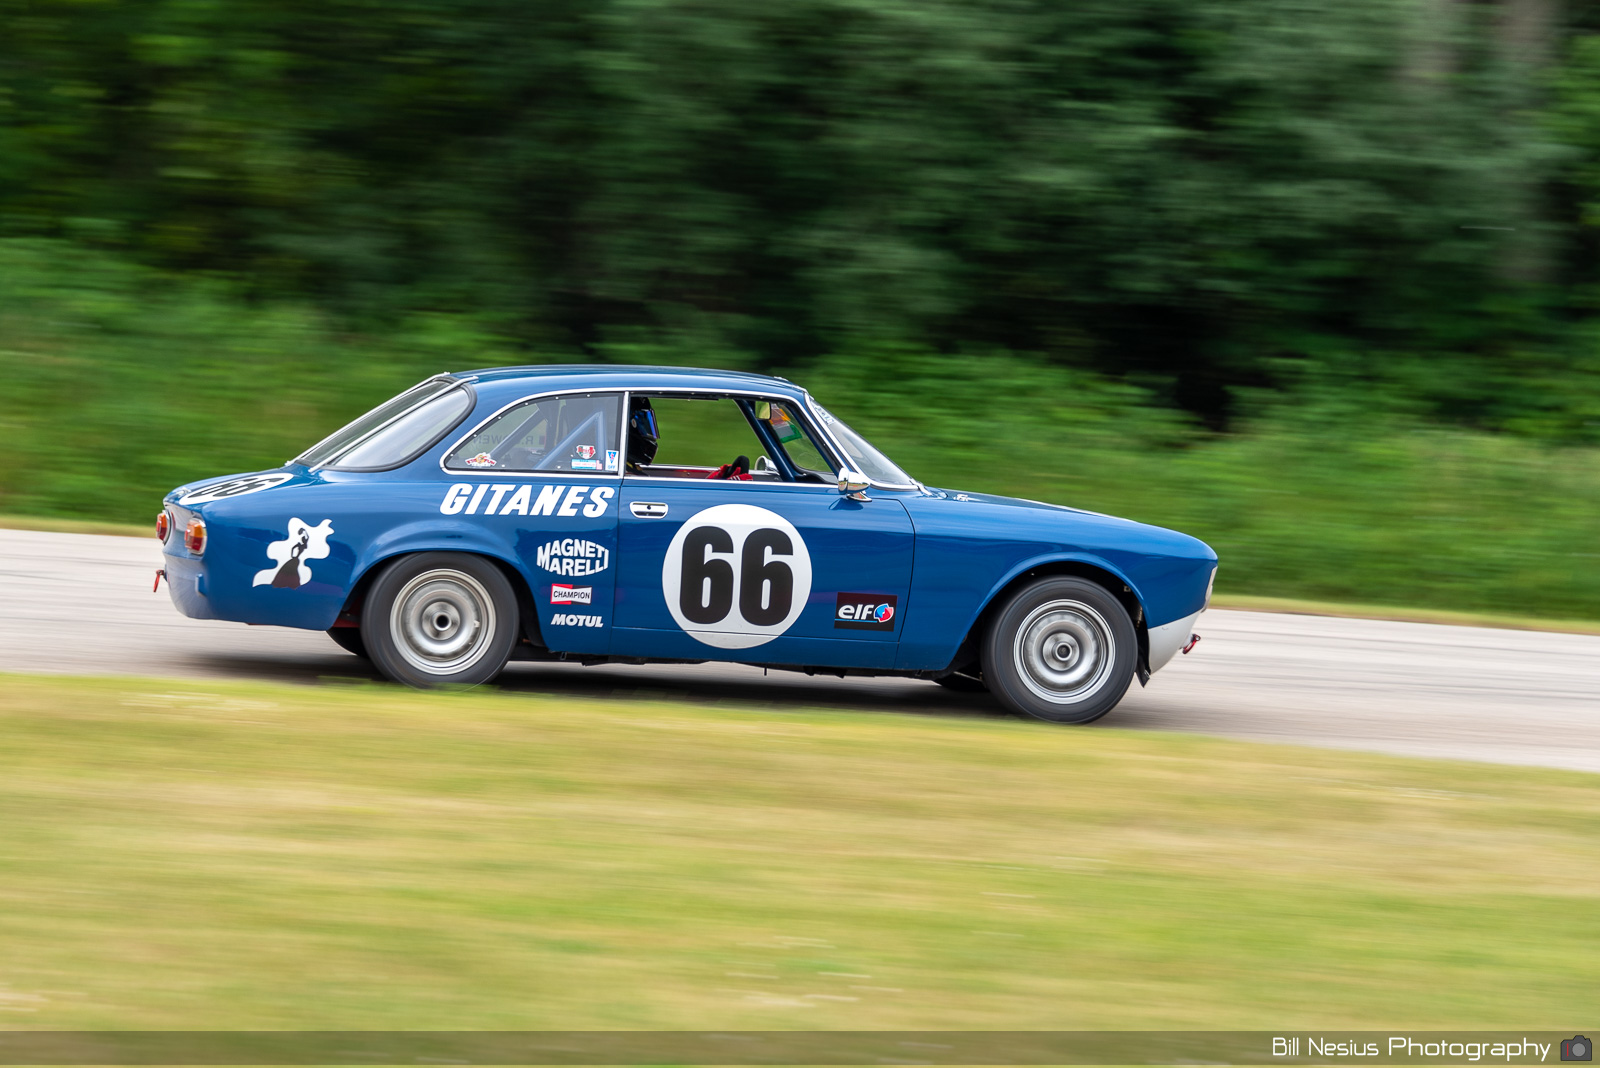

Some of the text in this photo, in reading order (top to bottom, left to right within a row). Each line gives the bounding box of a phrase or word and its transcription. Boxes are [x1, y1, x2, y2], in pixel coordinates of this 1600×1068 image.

[439, 483, 615, 518] GITANES
[536, 538, 609, 560] MAGNETI
[680, 525, 794, 627] 66
[553, 590, 591, 600] CHAMPION
[551, 613, 604, 628] MOTUL
[838, 603, 875, 620] elf
